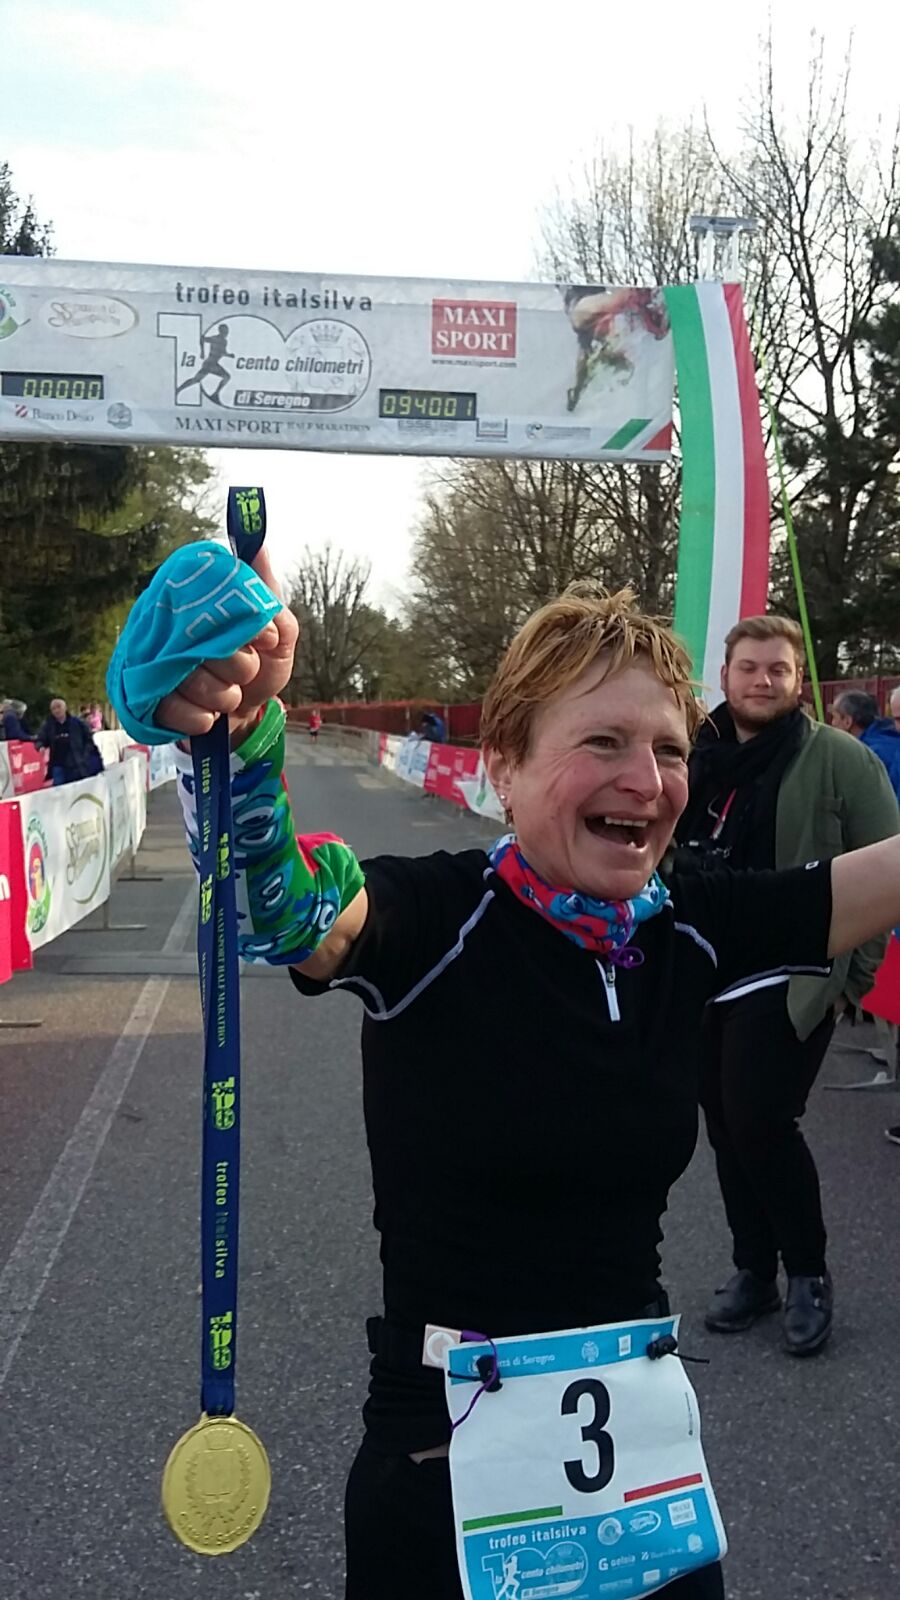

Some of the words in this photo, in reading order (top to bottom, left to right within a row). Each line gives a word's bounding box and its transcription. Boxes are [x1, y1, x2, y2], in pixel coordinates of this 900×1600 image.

[175, 282, 250, 305] trofeo
[263, 286, 373, 311] italsilva
[443, 306, 506, 327] MAXI
[435, 330, 513, 351] SPORT
[181, 351, 196, 367] la
[236, 355, 280, 372] cento
[285, 356, 364, 375] chilometri
[432, 358, 517, 369] www.maxisport.com
[23, 378, 102, 400] 00000
[236, 392, 250, 404] di
[254, 391, 311, 409] Seregno
[175, 416, 223, 432] MAXI
[226, 418, 281, 434] SPORT
[202, 756, 211, 794] trofeo
[215, 1161, 229, 1205] trofeo
[513, 1357, 520, 1366] di
[522, 1354, 556, 1365] Seregno
[561, 1378, 615, 1494] 3
[489, 1534, 527, 1550] trofeo
[532, 1524, 587, 1542] italsilva
